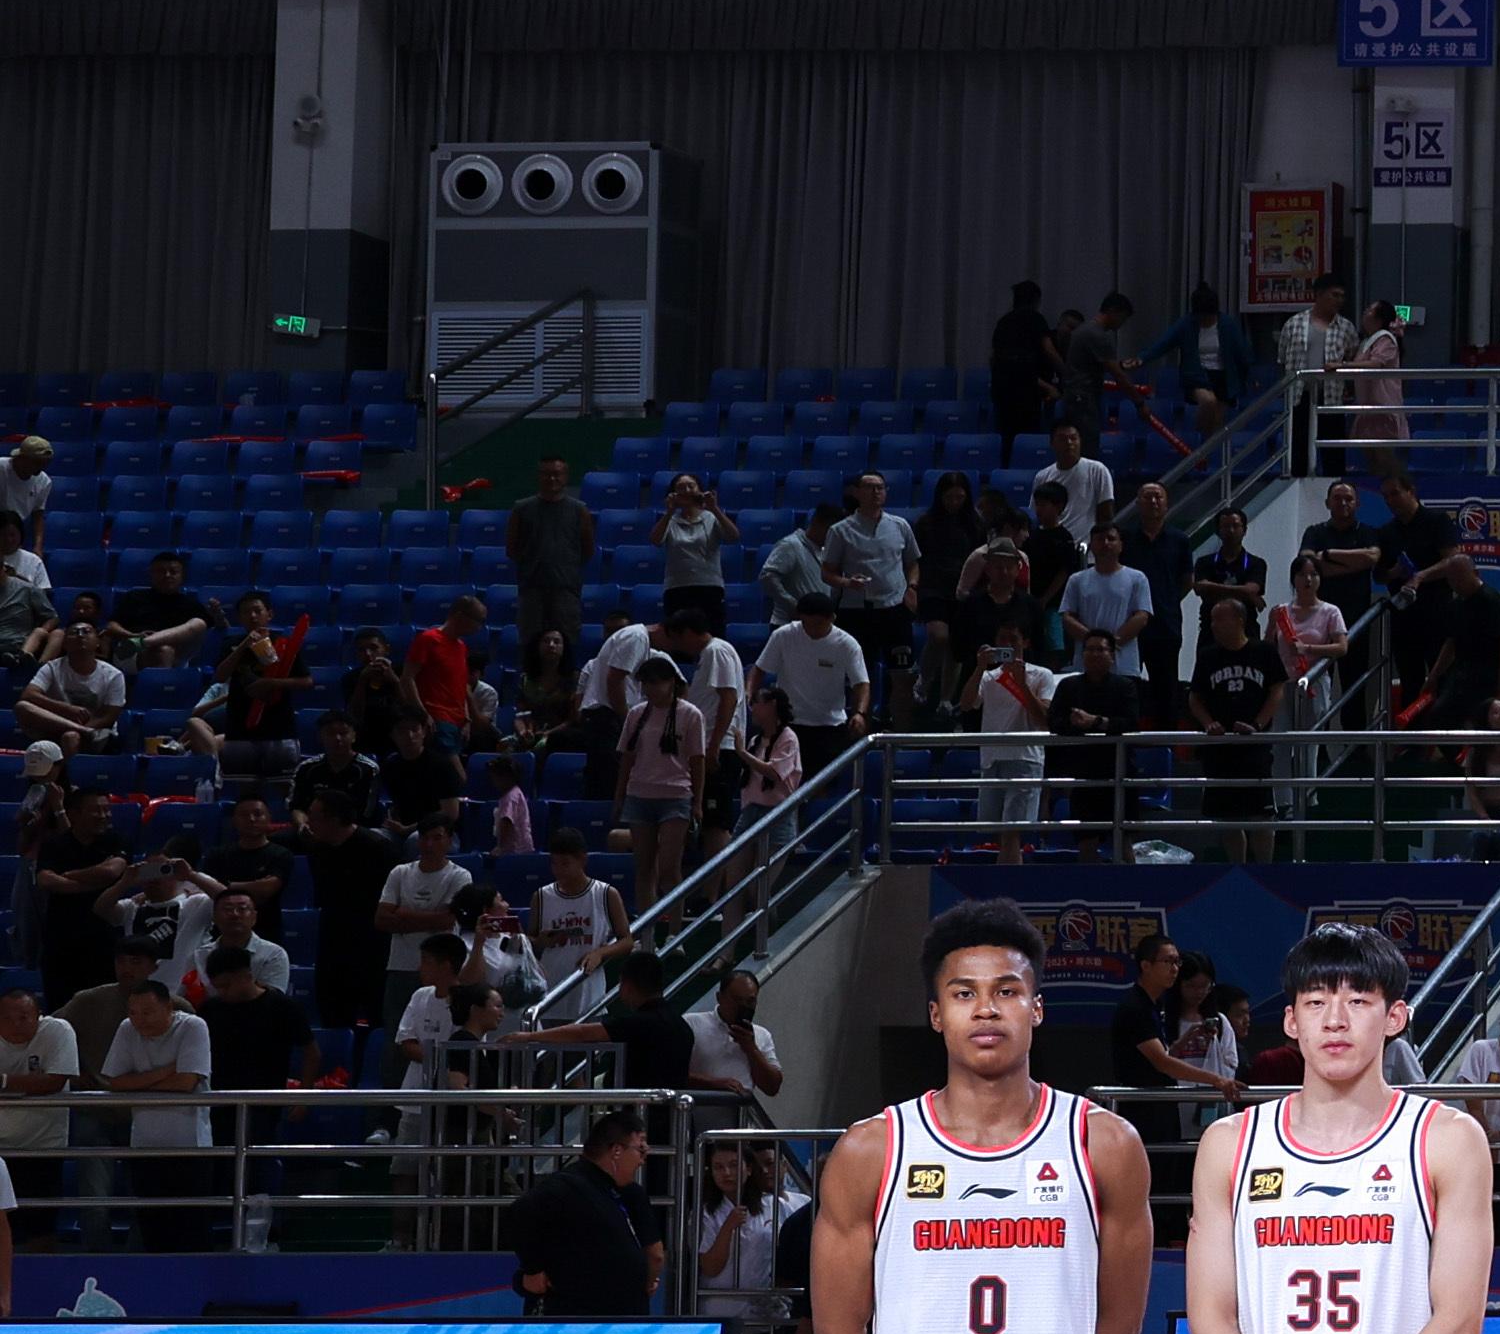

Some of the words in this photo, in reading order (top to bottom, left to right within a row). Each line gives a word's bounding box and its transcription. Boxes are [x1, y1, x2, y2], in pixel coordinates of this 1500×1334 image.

[1353, 42, 1478, 58] 请爱护公共设施
[1039, 1194, 1059, 1203] CGB
[1371, 1193, 1390, 1202] CGB
[913, 1217, 1066, 1251] GUANGDONG
[1255, 1214, 1394, 1247] GUANGDONG
[1287, 1269, 1361, 1333] 35
